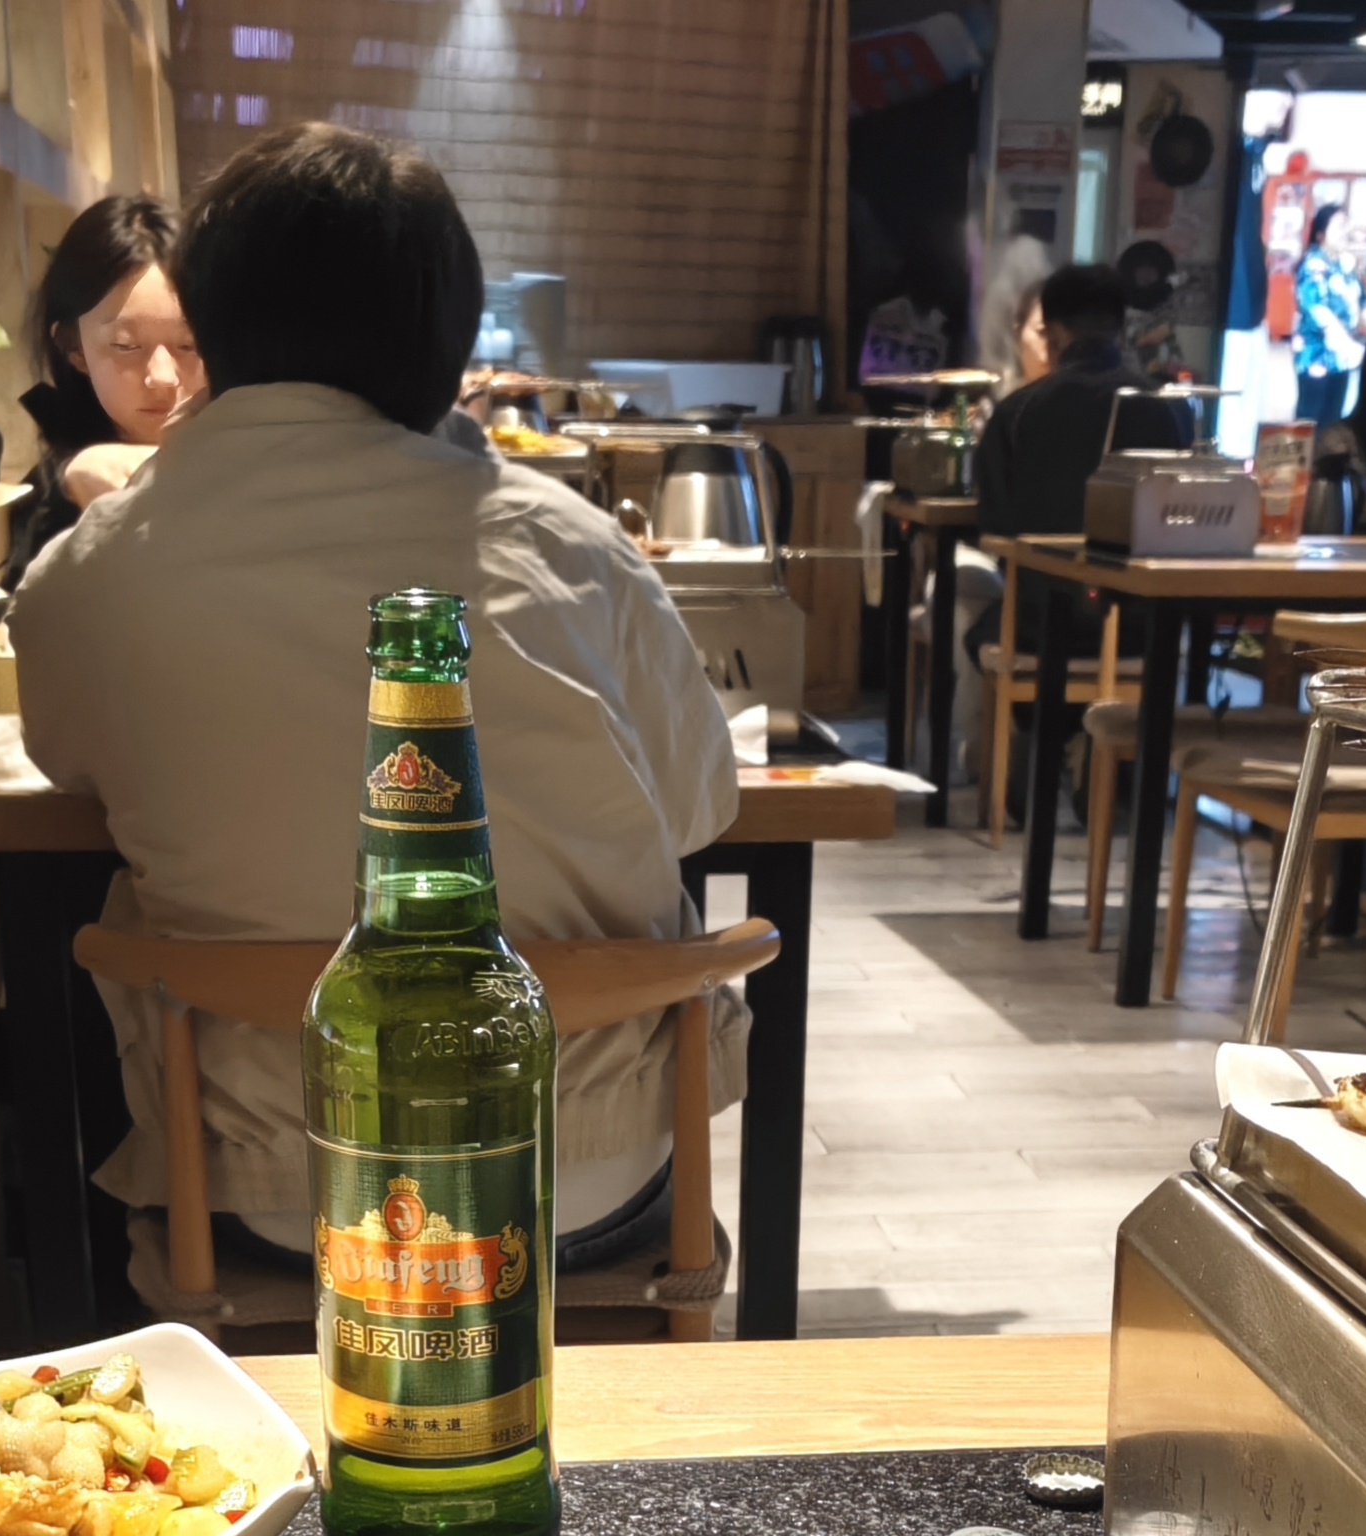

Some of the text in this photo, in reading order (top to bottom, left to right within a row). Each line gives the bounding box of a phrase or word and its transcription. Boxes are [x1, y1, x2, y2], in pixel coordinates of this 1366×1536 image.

[370, 790, 454, 813] 佳凤啤酒
[336, 1243, 485, 1294] Jiafeng
[333, 1315, 499, 1361] 佳凤啤酒
[364, 1411, 463, 1433] 佳木斯味道
